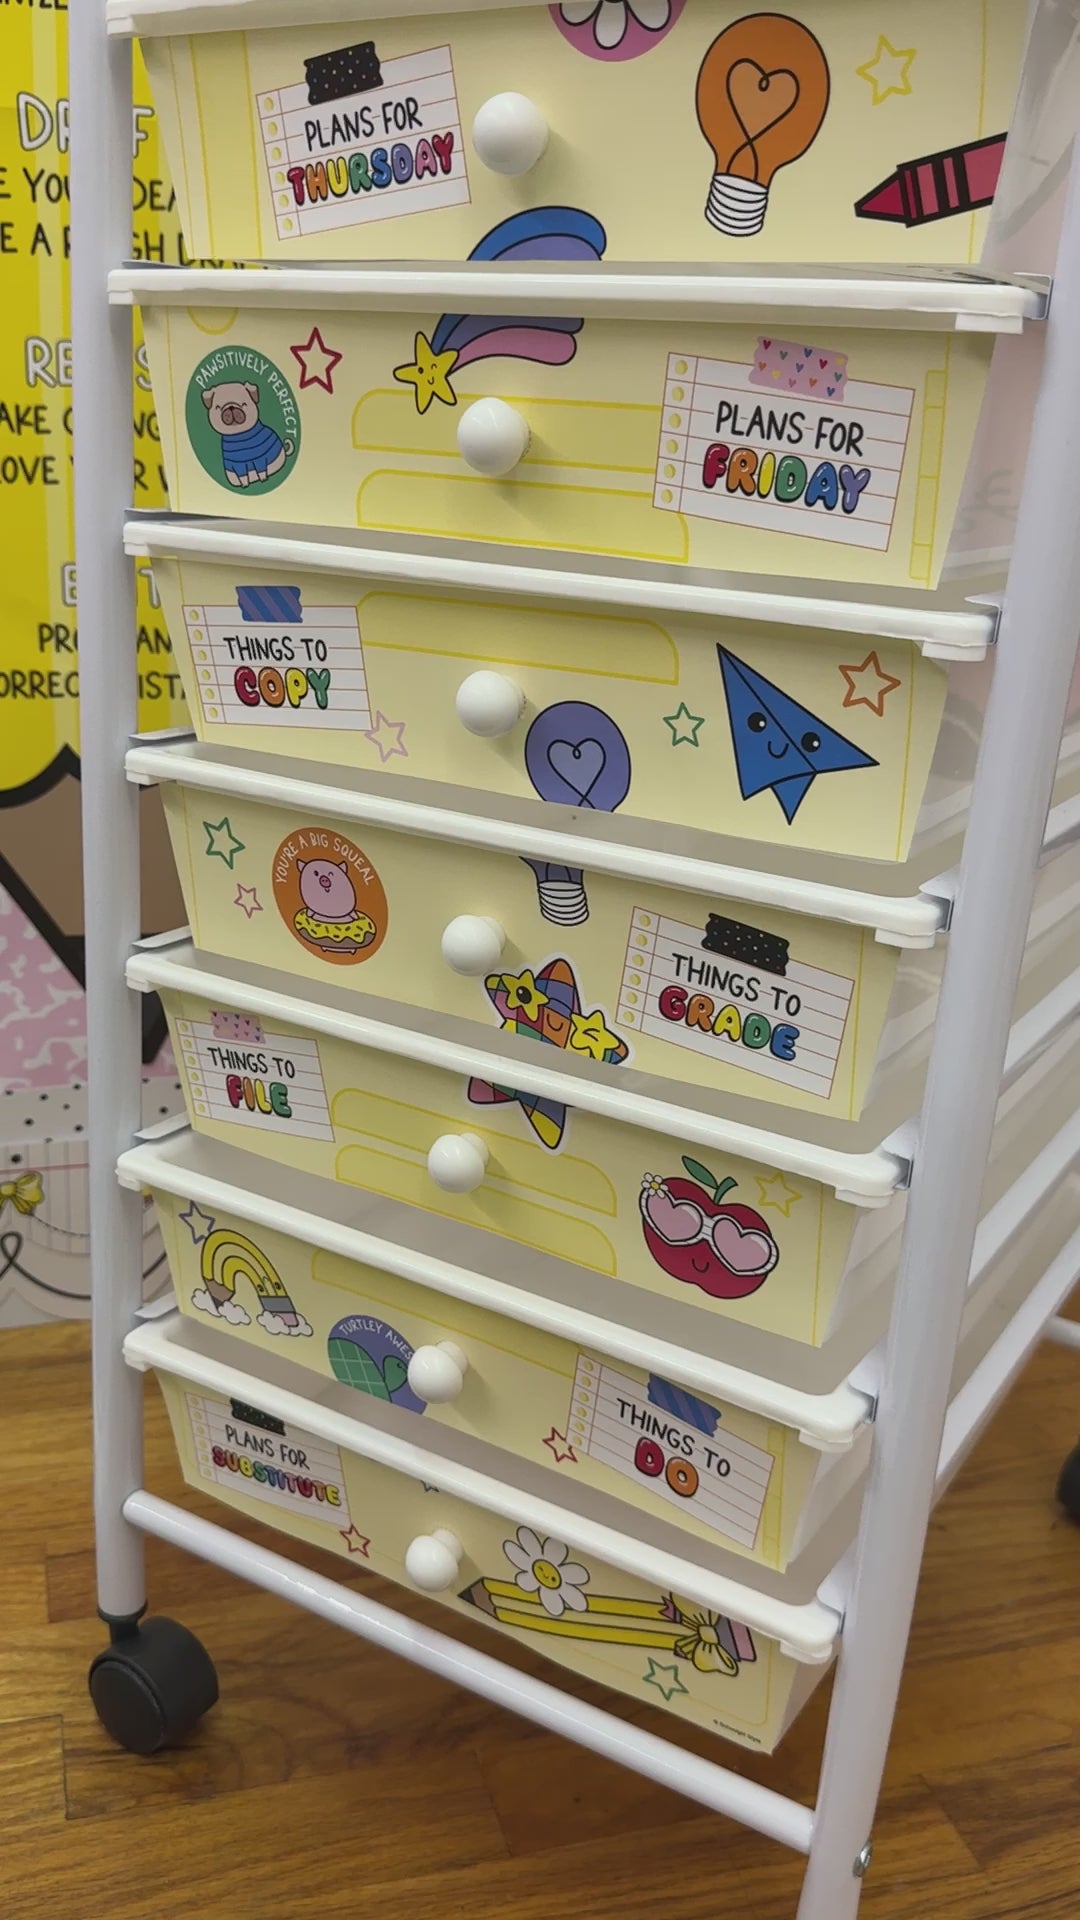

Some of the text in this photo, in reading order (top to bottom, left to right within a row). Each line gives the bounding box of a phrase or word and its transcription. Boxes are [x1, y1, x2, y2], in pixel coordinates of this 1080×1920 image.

[305, 98, 423, 151] PLANS FOR
[287, 132, 454, 206] THURSDAY
[31, 222, 52, 256] A
[0, 402, 51, 436] AKE
[195, 351, 298, 438] PAWSITIVELY PERFECT
[715, 400, 865, 457] PLANS FOR
[0, 455, 60, 486] OVE
[702, 443, 871, 514] FRIDAY
[223, 636, 328, 662] THINGS TO
[234, 666, 331, 710] COPY
[275, 832, 375, 885] YOU'RE A BIG SQUEAL
[672, 952, 801, 1017] THINGS TO
[658, 985, 800, 1061] GRADE
[207, 1047, 296, 1079] THINGS TO
[226, 1075, 292, 1118] FILE
[339, 1319, 414, 1360] TURTLEY AWES
[225, 1424, 310, 1470] PLANS FOR
[616, 1398, 731, 1477] THINGS TO
[212, 1445, 342, 1507] SUBSTITUTE
[634, 1436, 699, 1497] DO
